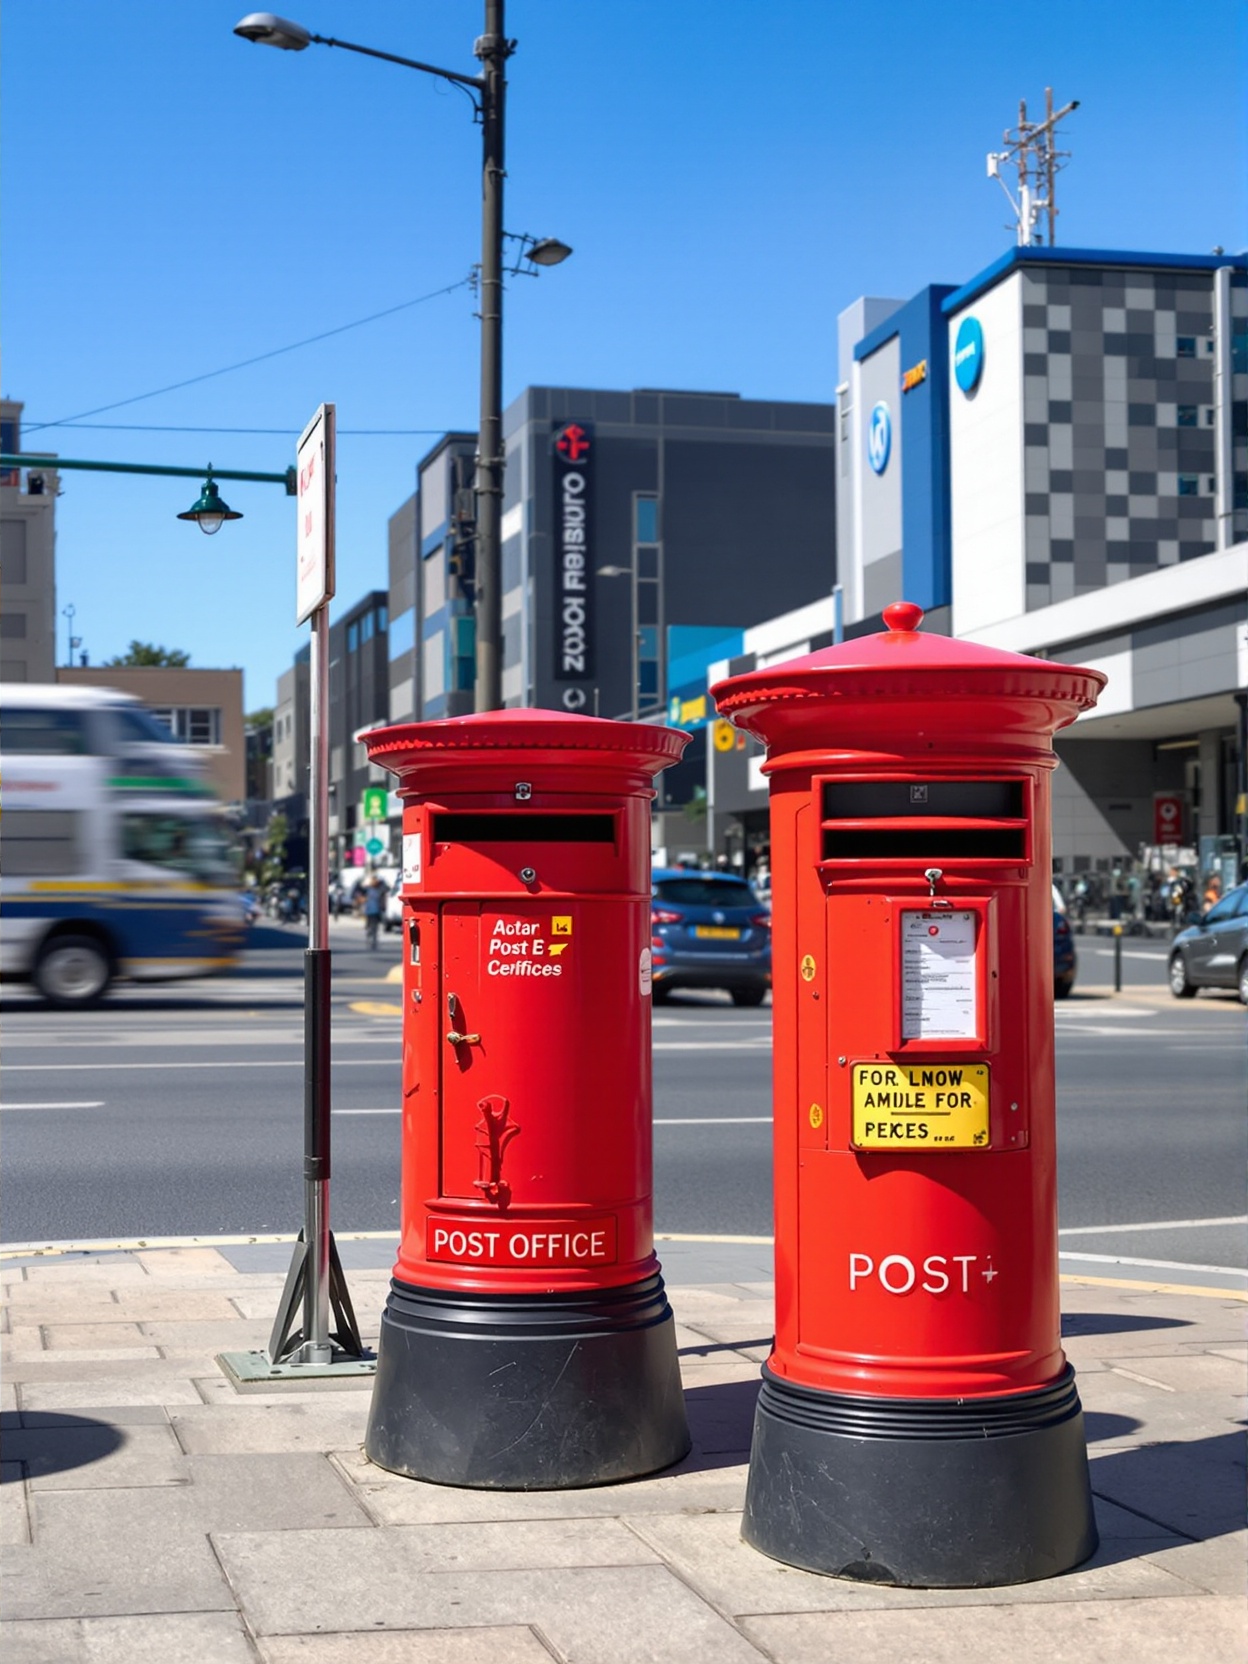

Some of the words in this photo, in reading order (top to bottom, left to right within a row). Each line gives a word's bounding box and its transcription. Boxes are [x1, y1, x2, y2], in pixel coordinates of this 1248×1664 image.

[489, 938, 529, 956] Post
[935, 1092, 972, 1108] FOR
[435, 1228, 500, 1258] POST
[509, 1231, 606, 1259] OFFICE
